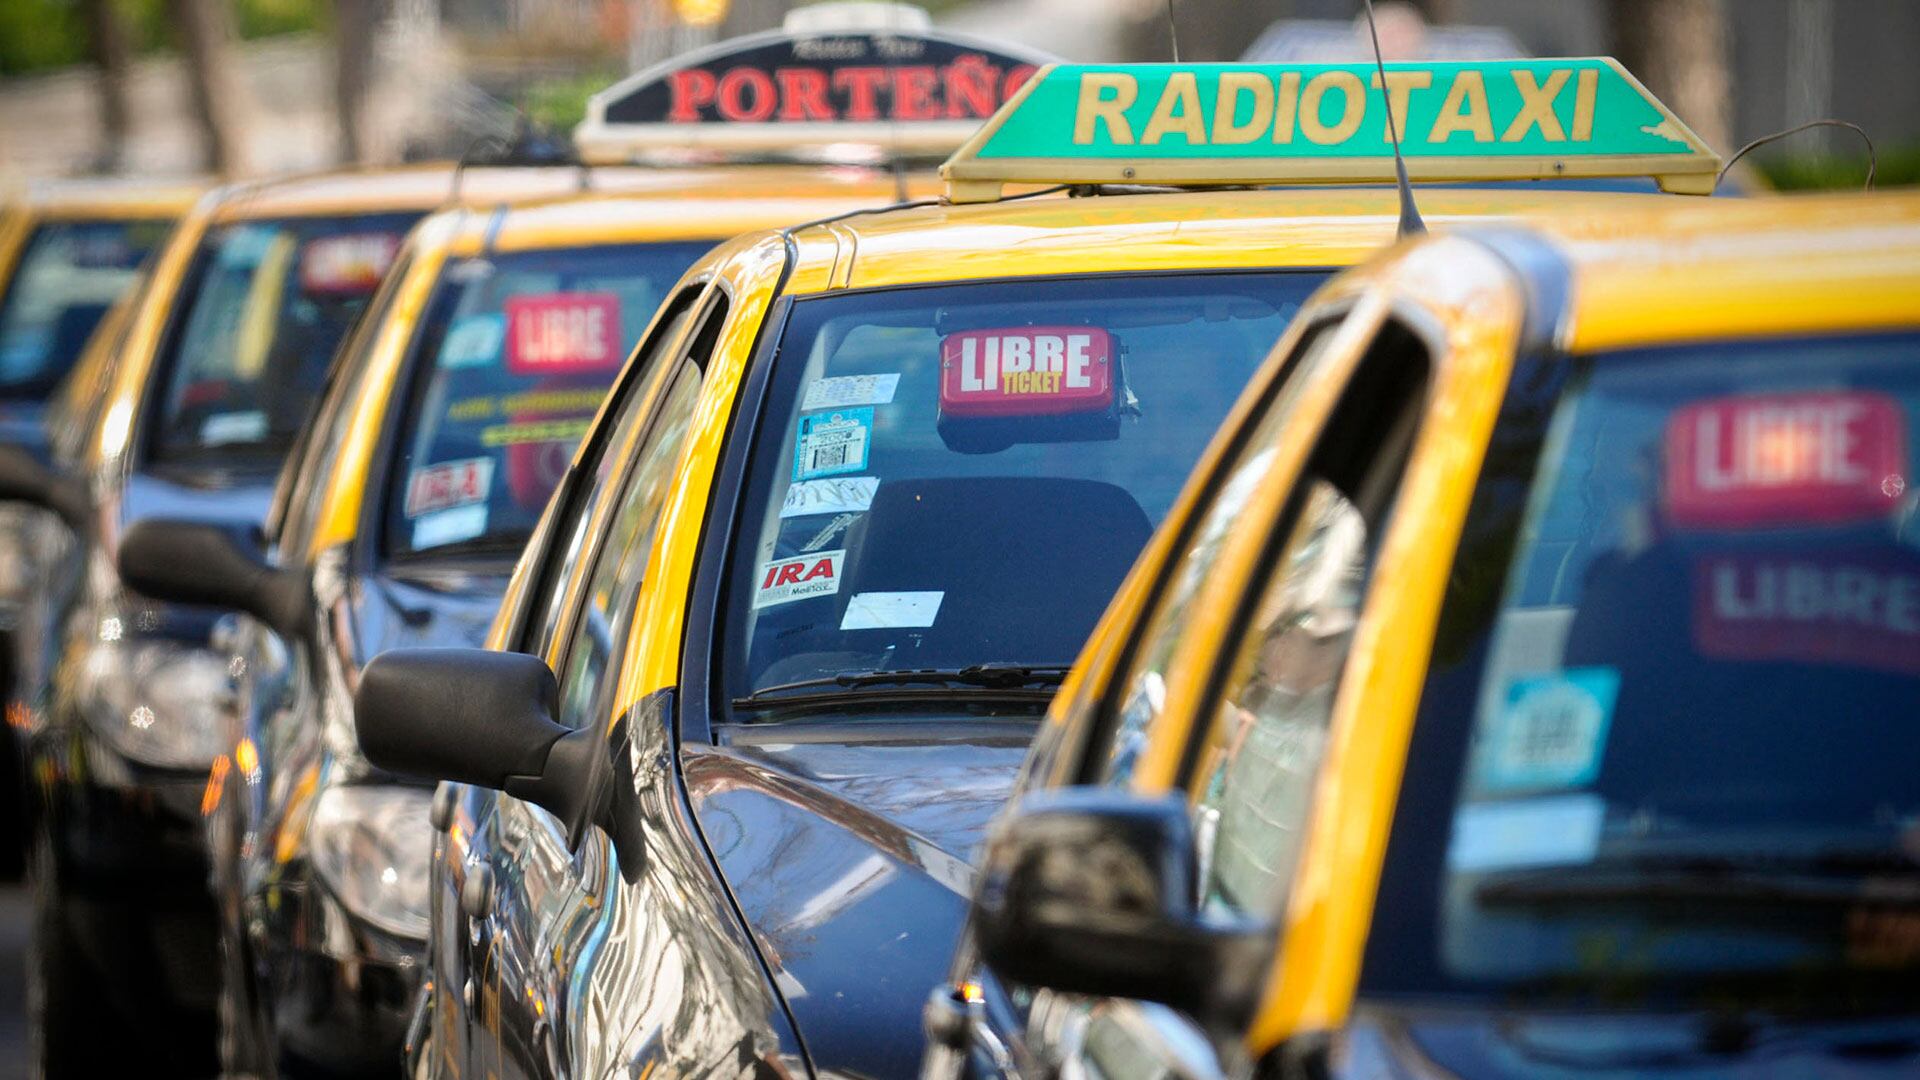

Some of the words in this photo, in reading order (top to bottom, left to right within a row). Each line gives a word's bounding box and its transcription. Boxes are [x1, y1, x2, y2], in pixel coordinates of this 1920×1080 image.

[961, 335, 1091, 392] LIBRE
[1002, 371, 1063, 395] TICKET
[761, 558, 833, 590] IRA
[1714, 566, 1920, 633] LIBRE
